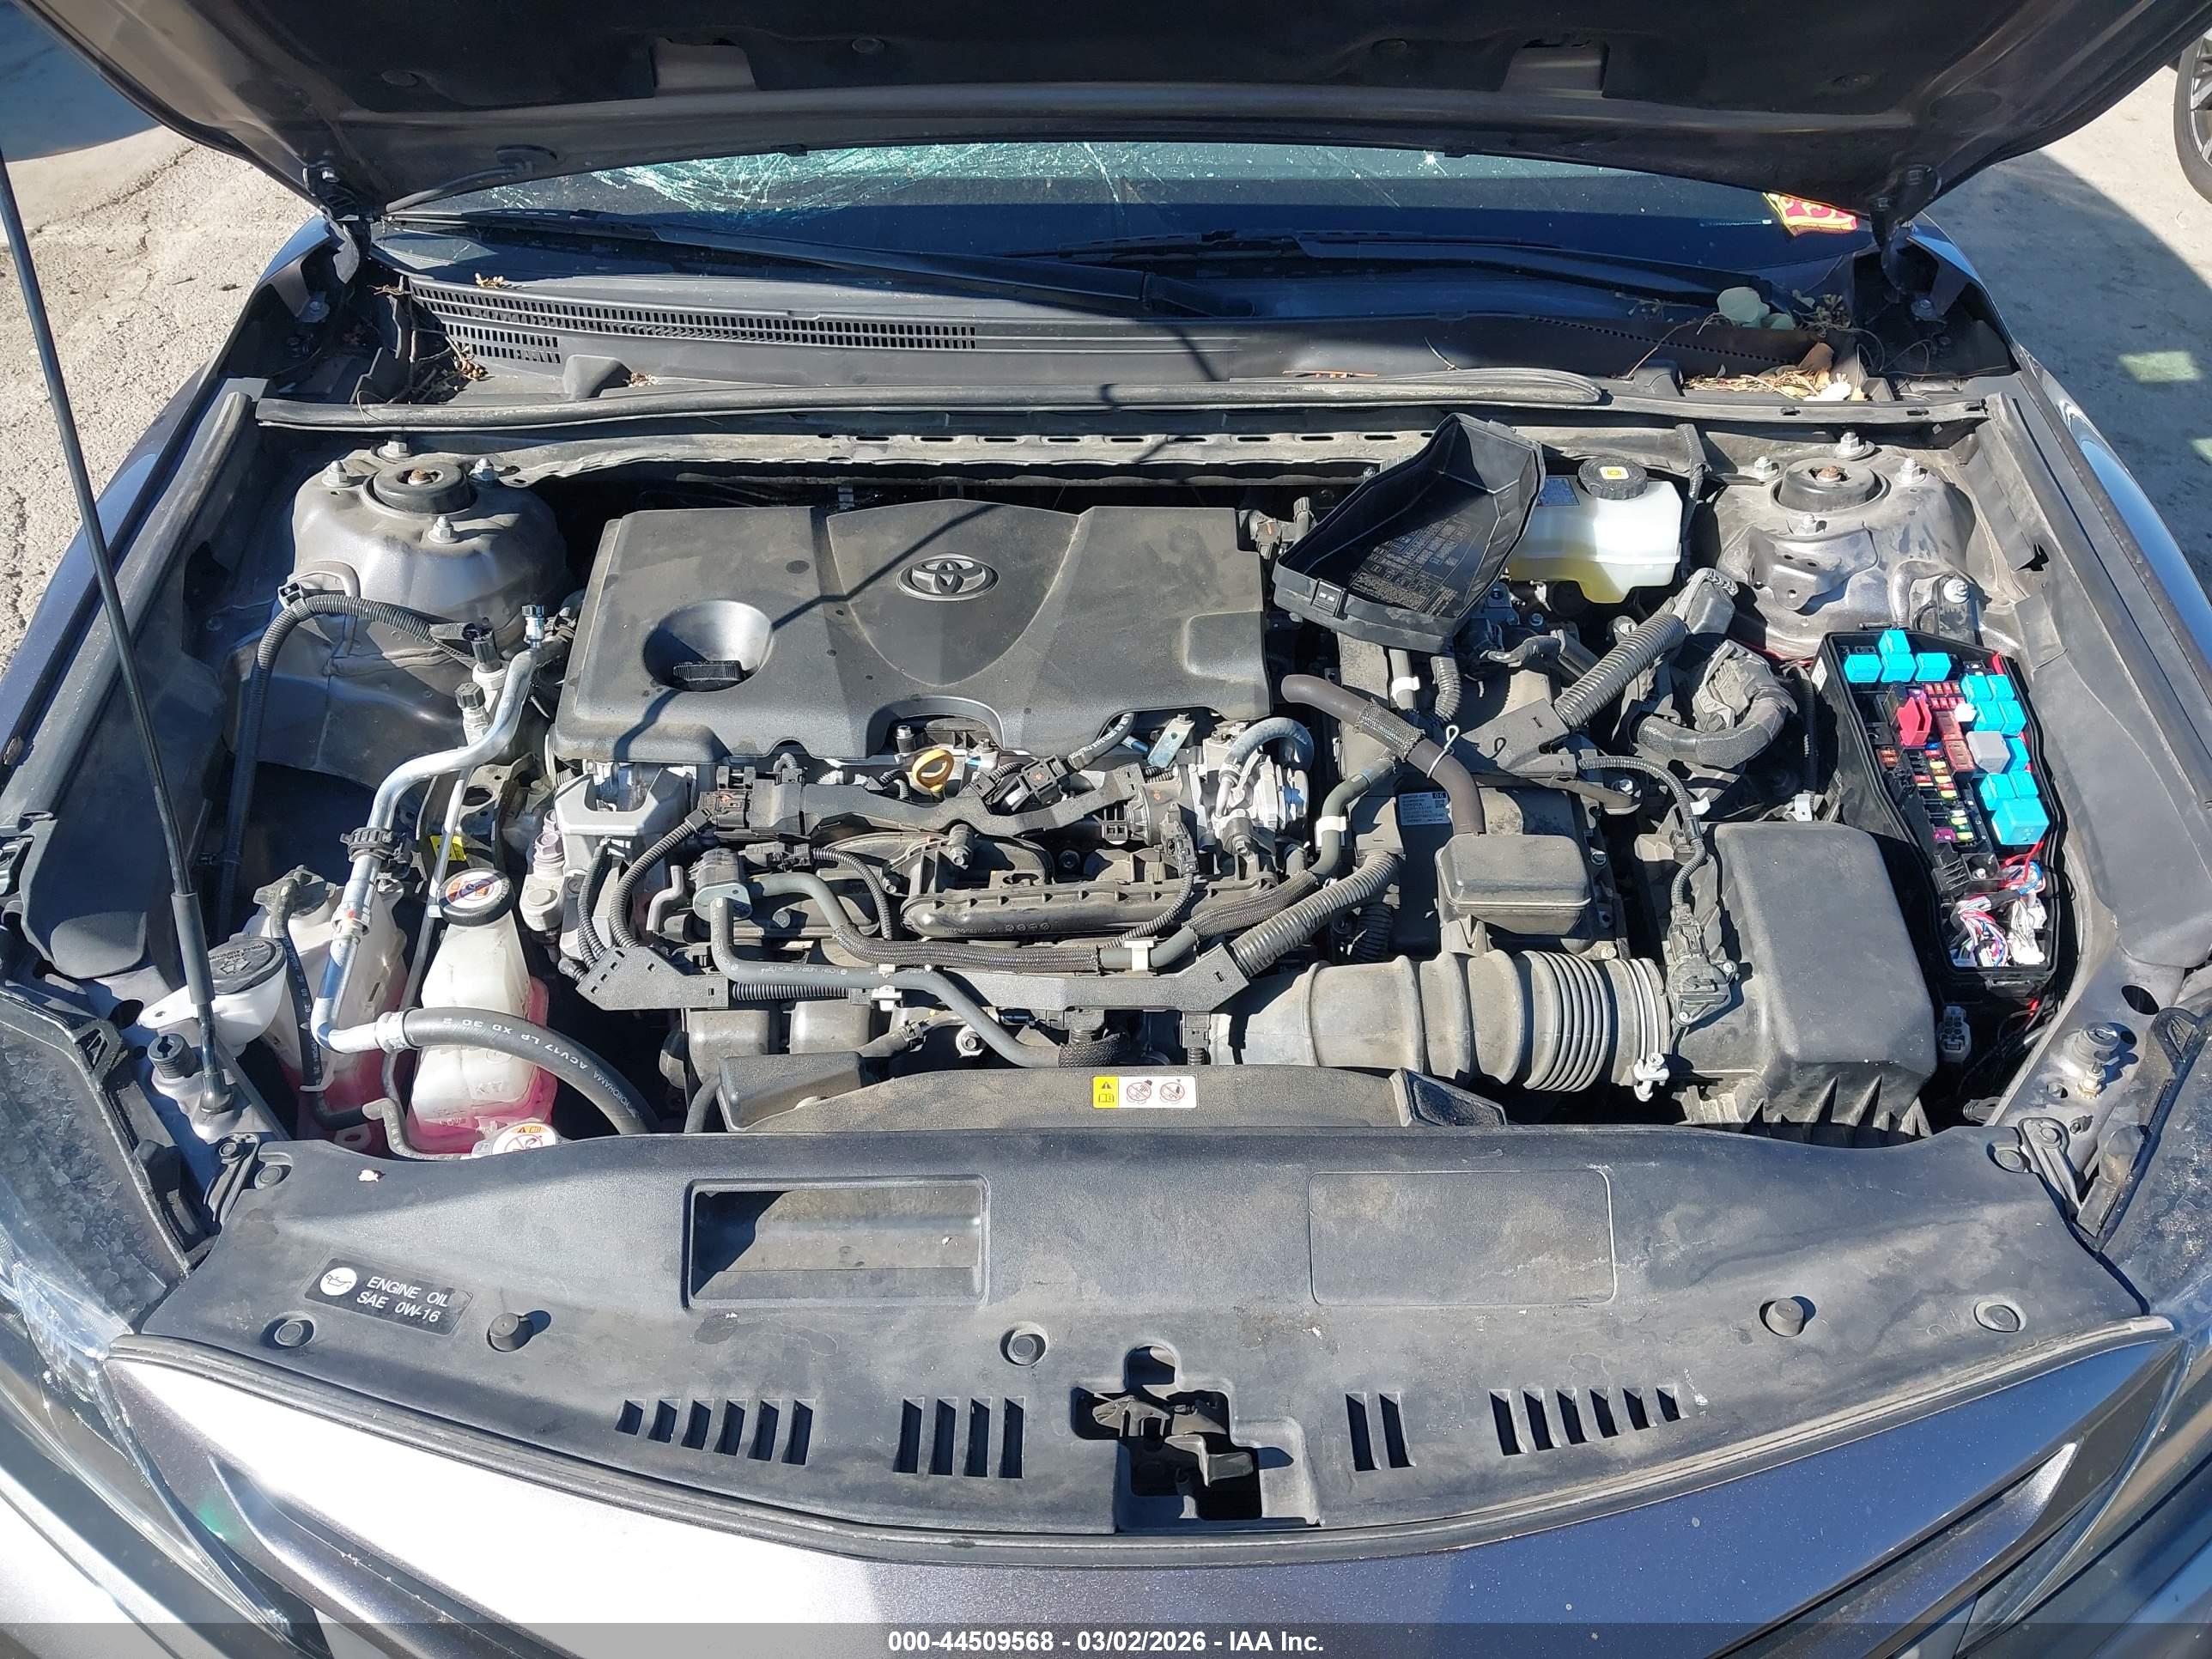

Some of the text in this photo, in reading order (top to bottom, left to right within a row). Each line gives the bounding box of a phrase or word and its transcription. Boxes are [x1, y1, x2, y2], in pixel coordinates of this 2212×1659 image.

[462, 1018, 483, 1028] 30
[491, 1023, 514, 1035] XD
[520, 1033, 541, 1046] LP
[544, 1043, 588, 1071] ACV17
[592, 1071, 632, 1109] YOKOHAMA
[367, 1276, 450, 1308] ENGINE OIL
[356, 1291, 441, 1323] SAE 0W-16
